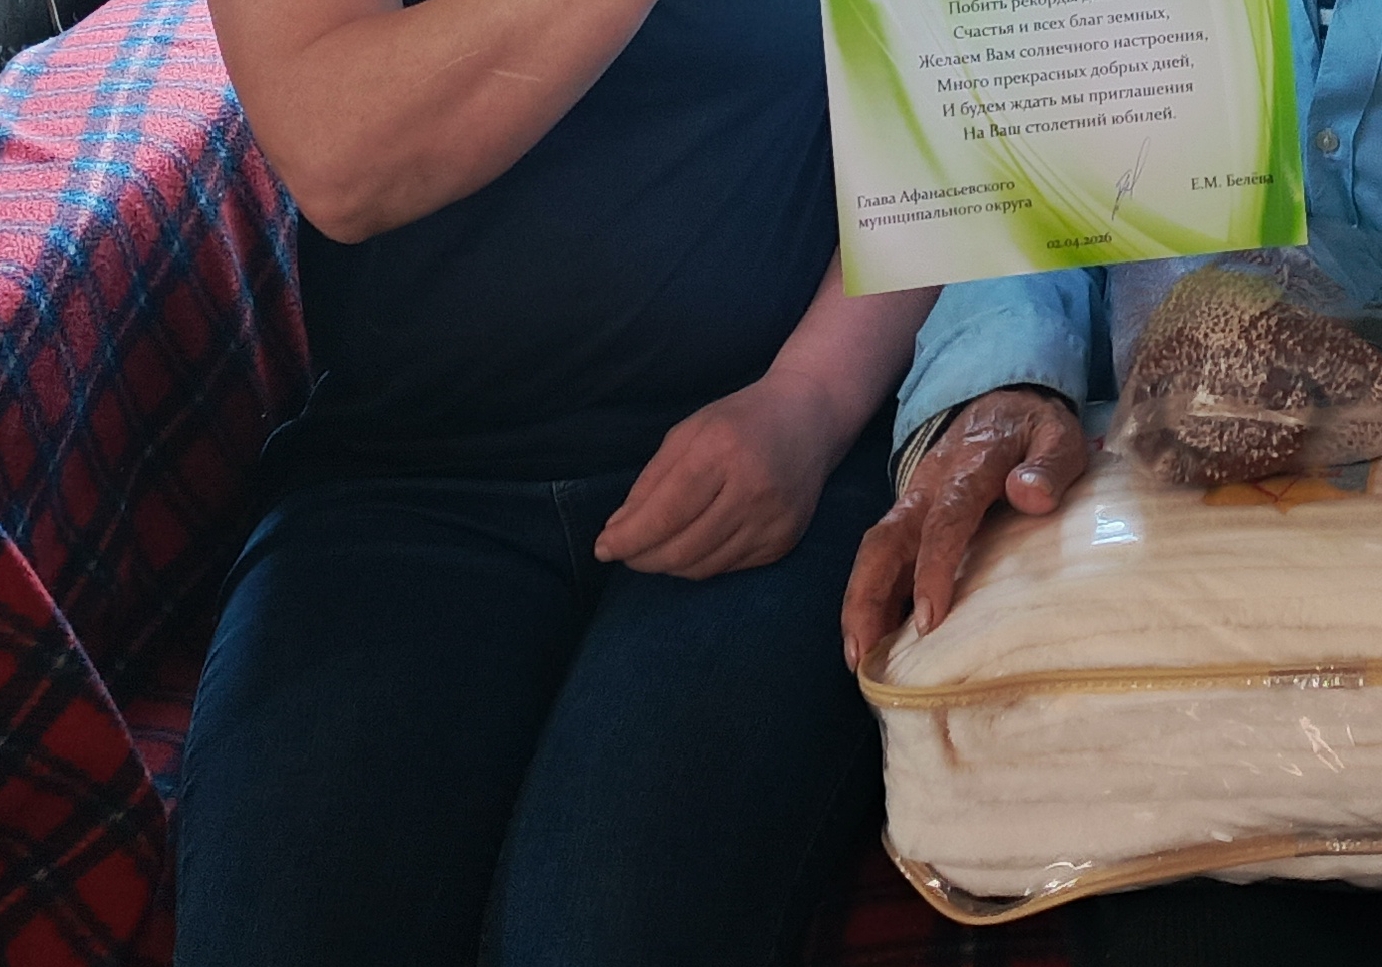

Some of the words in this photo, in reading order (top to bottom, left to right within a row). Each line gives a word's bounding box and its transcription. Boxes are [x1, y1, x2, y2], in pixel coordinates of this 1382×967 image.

[954, 23, 1014, 40] Счастья
[1019, 23, 1029, 33] и
[1033, 17, 1065, 32] всех
[1069, 13, 1103, 27] благ
[1107, 8, 1170, 24] земных,
[919, 53, 981, 70] Желаем
[986, 47, 1015, 62] Вам
[1019, 40, 1109, 58] солнечного
[1113, 30, 1208, 49] настроения,
[937, 77, 989, 93] Много
[993, 67, 1087, 88] прекрасных
[1090, 60, 1149, 79] добрых
[1152, 53, 1194, 72] дней,
[942, 103, 956, 117] И
[960, 100, 1006, 118] будем
[1010, 95, 1057, 110] ждать
[1061, 93, 1084, 105] мы
[1089, 81, 1193, 104] приглашения
[963, 127, 984, 141] На
[990, 123, 1021, 138] Ваш
[1025, 113, 1106, 134] столетний
[1111, 105, 1177, 125] юбилей.
[857, 194, 896, 209] Глава
[900, 181, 1015, 204] Афанасьевского
[1191, 176, 1222, 191] Е.М.
[1226, 172, 1274, 187] Белёва
[858, 204, 982, 230] муниципального
[985, 197, 1033, 215] округа
[1046, 232, 1112, 249] 02.04.2026
